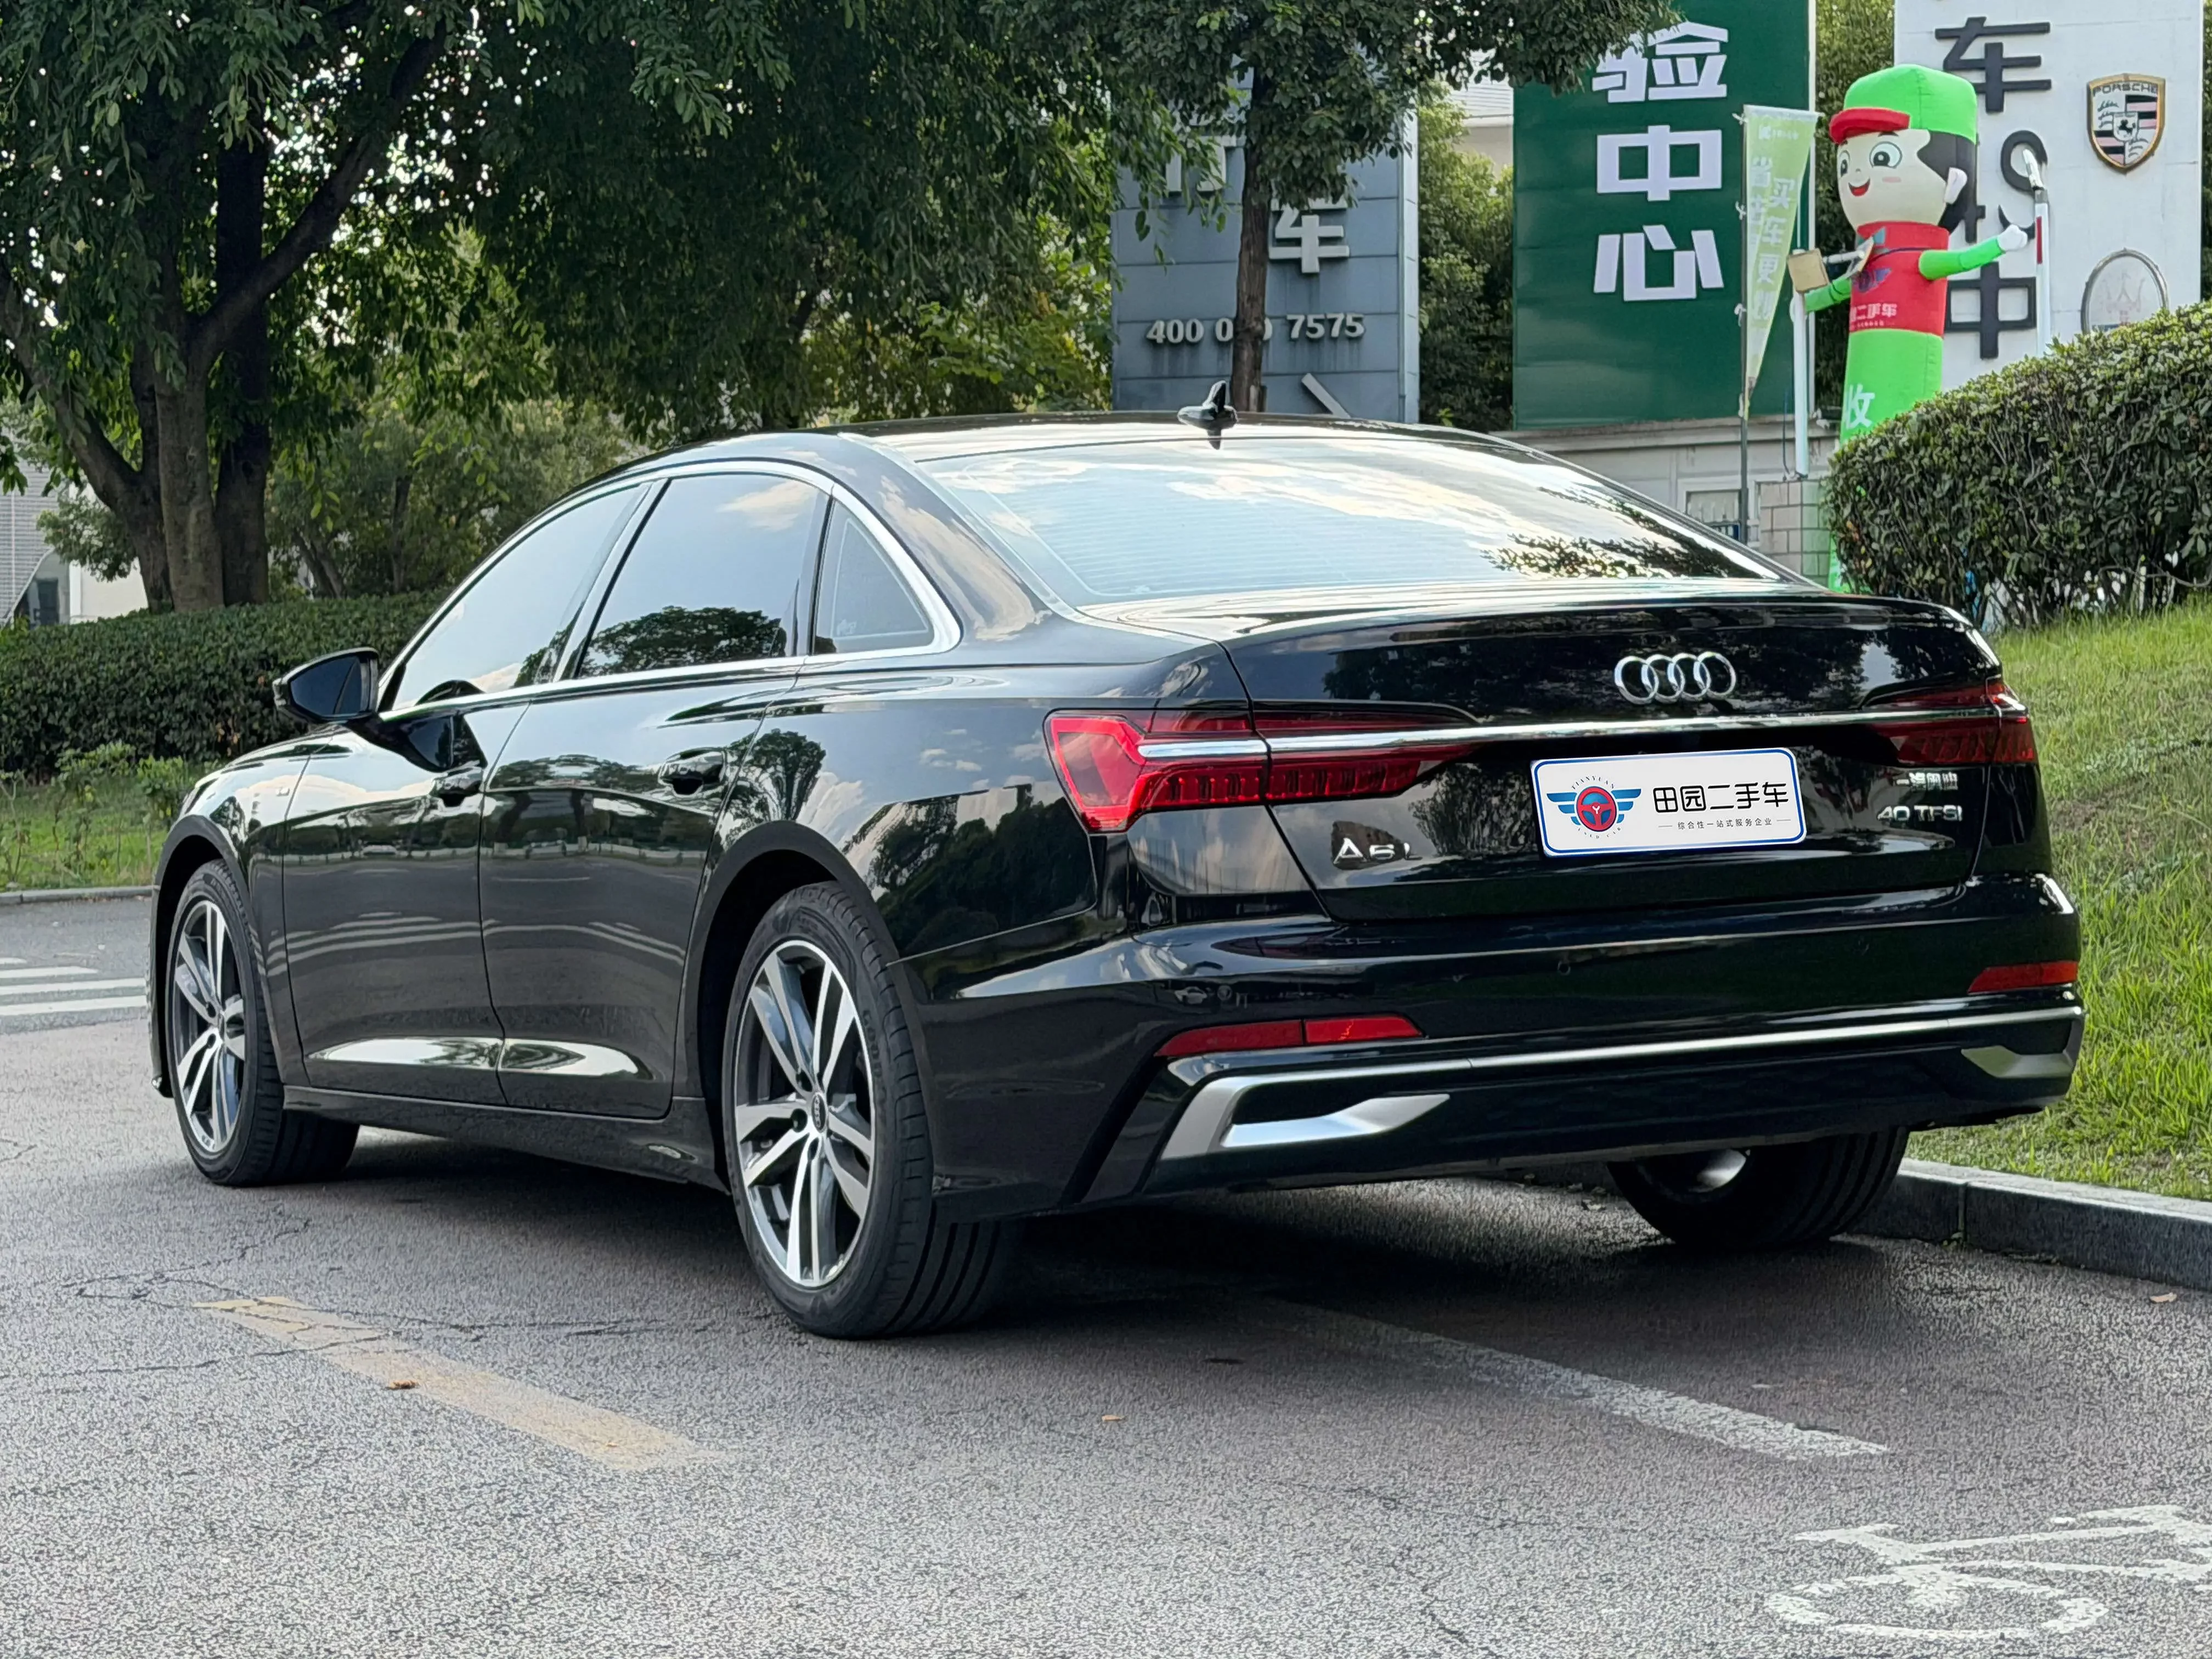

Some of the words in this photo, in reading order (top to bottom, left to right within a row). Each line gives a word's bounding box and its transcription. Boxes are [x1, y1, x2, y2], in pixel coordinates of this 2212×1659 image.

[2093, 83, 2158, 97] PORSCHE
[1592, 21, 1728, 301] 验中心
[1146, 319, 1204, 343] 400
[1286, 313, 1365, 339] 7575
[1653, 782, 1788, 813] 田园二手车
[1678, 817, 1772, 830] 综合性一站式服务企业
[1877, 805, 1910, 821] 40
[1914, 805, 1962, 822] TFSI
